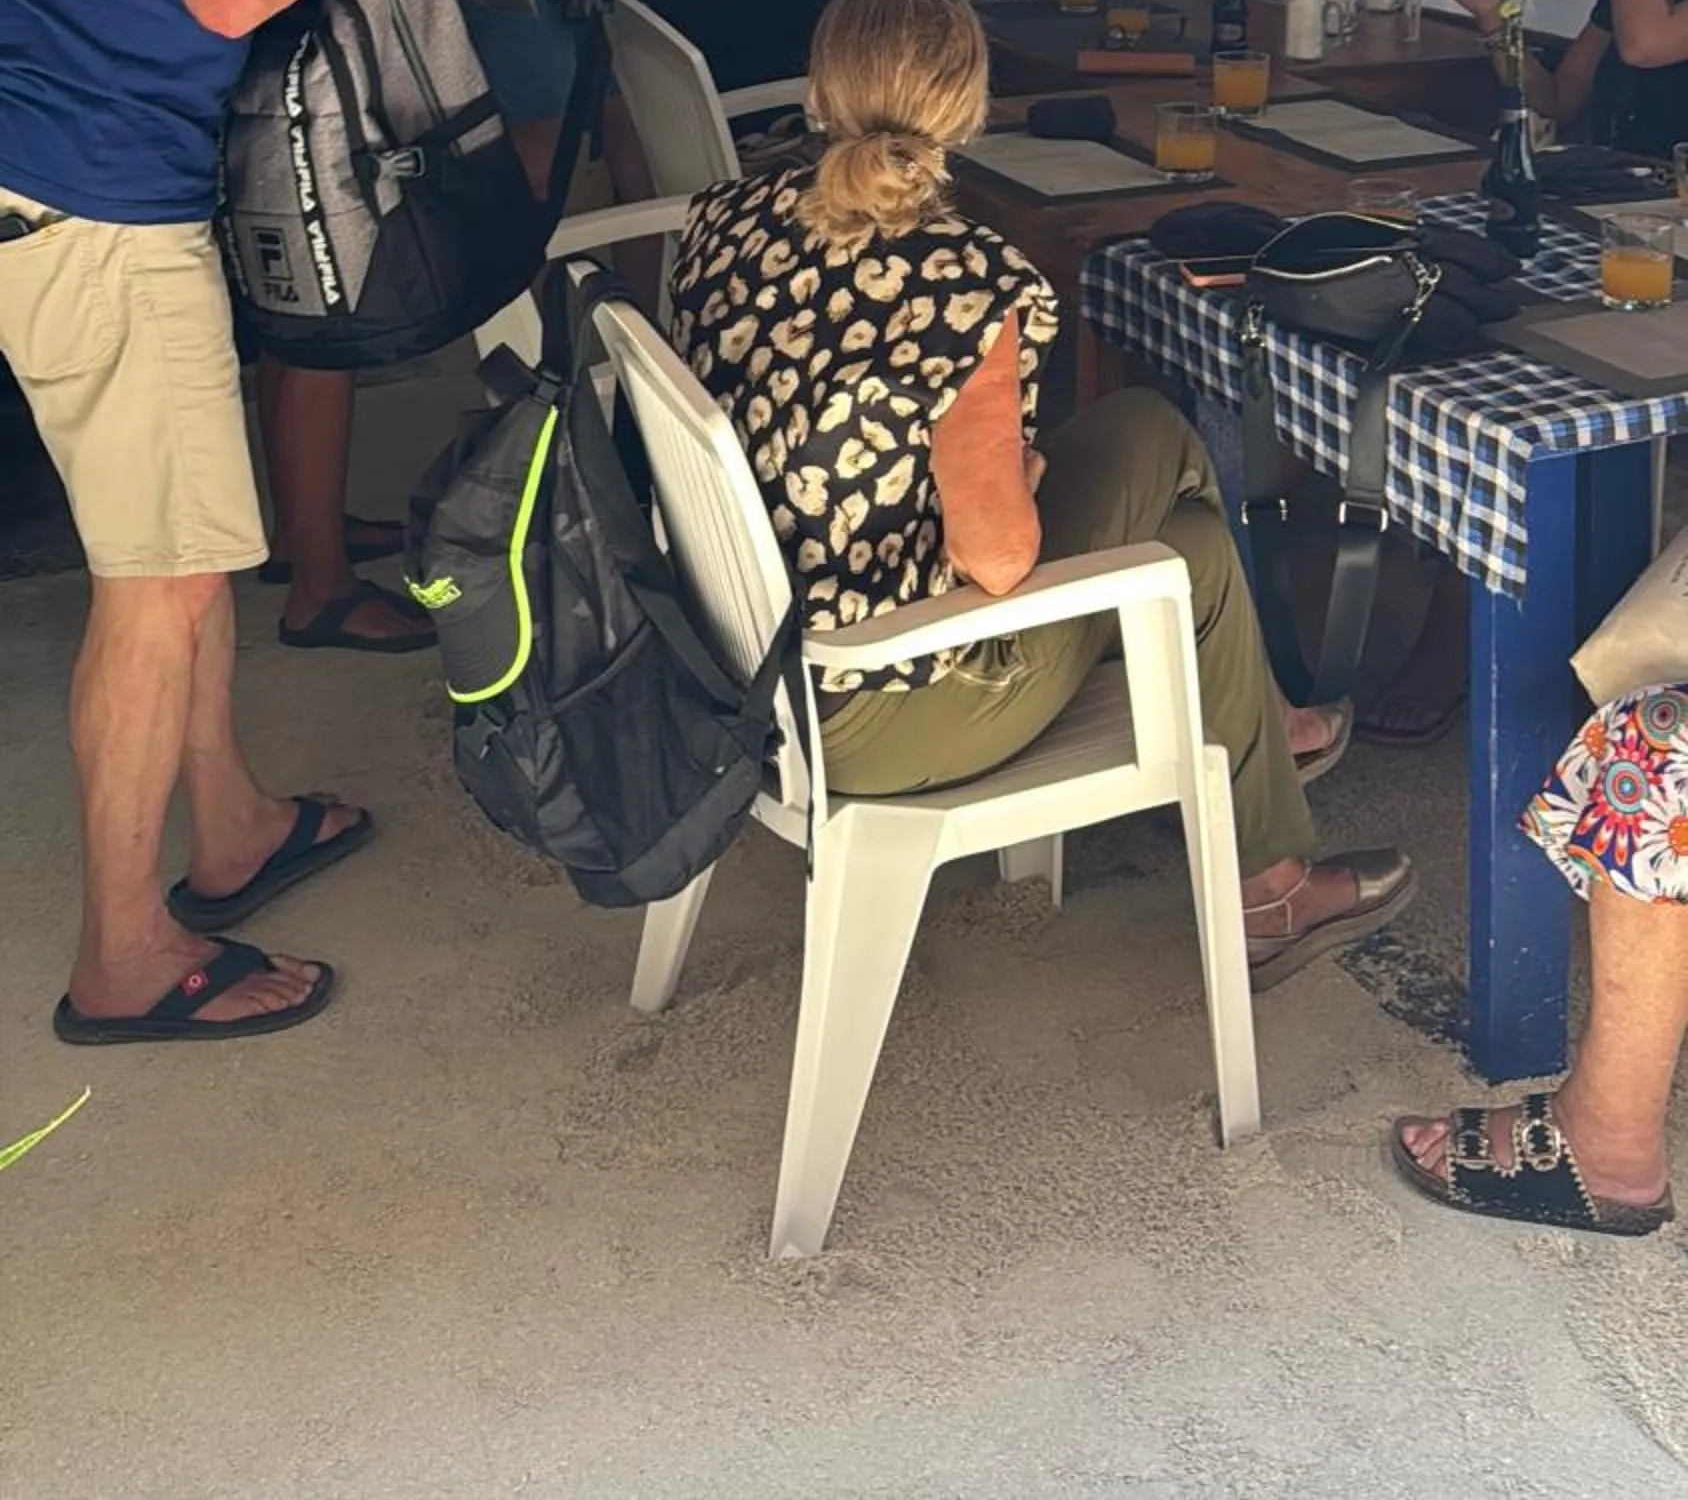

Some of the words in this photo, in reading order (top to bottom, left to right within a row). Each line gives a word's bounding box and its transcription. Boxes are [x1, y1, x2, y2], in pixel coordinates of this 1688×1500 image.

[297, 167, 316, 213] FILA
[263, 282, 300, 302] FILA
[318, 263, 341, 305] FILA
